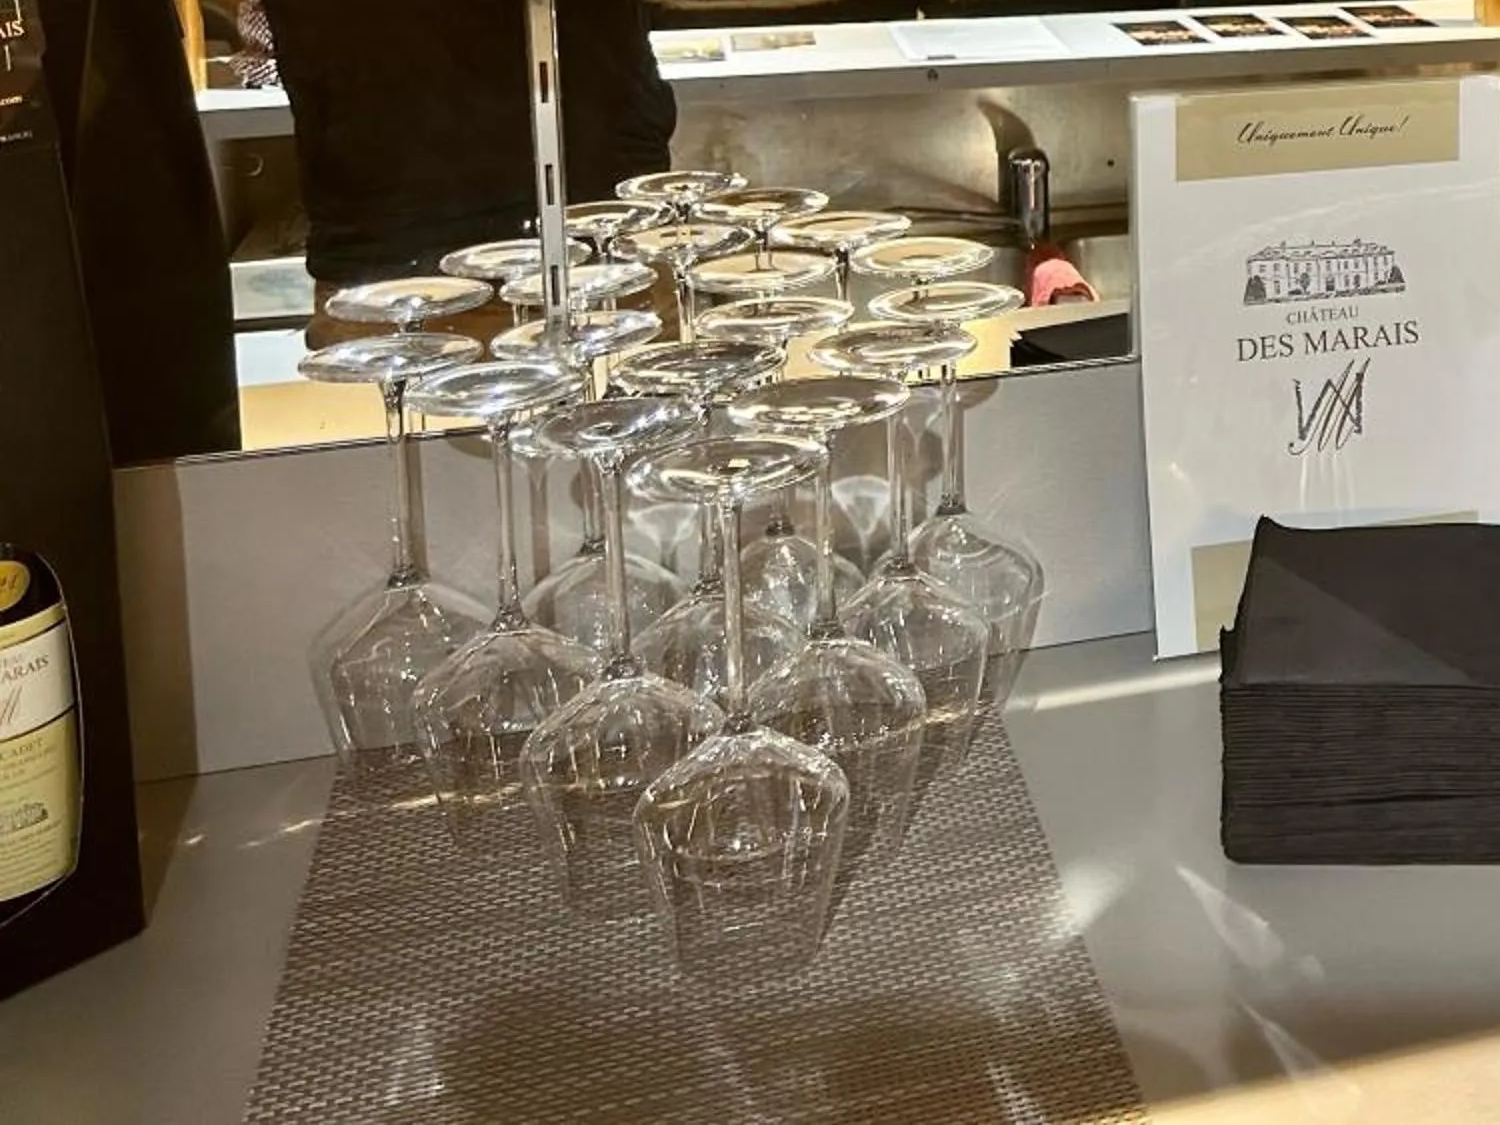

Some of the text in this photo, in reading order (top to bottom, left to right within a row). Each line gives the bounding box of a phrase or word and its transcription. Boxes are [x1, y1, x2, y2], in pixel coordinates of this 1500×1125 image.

[1236, 112, 1410, 147] Uniquement Unique!
[1286, 306, 1360, 325] CHÂTEAU
[1236, 320, 1420, 362] DES MARAIS
